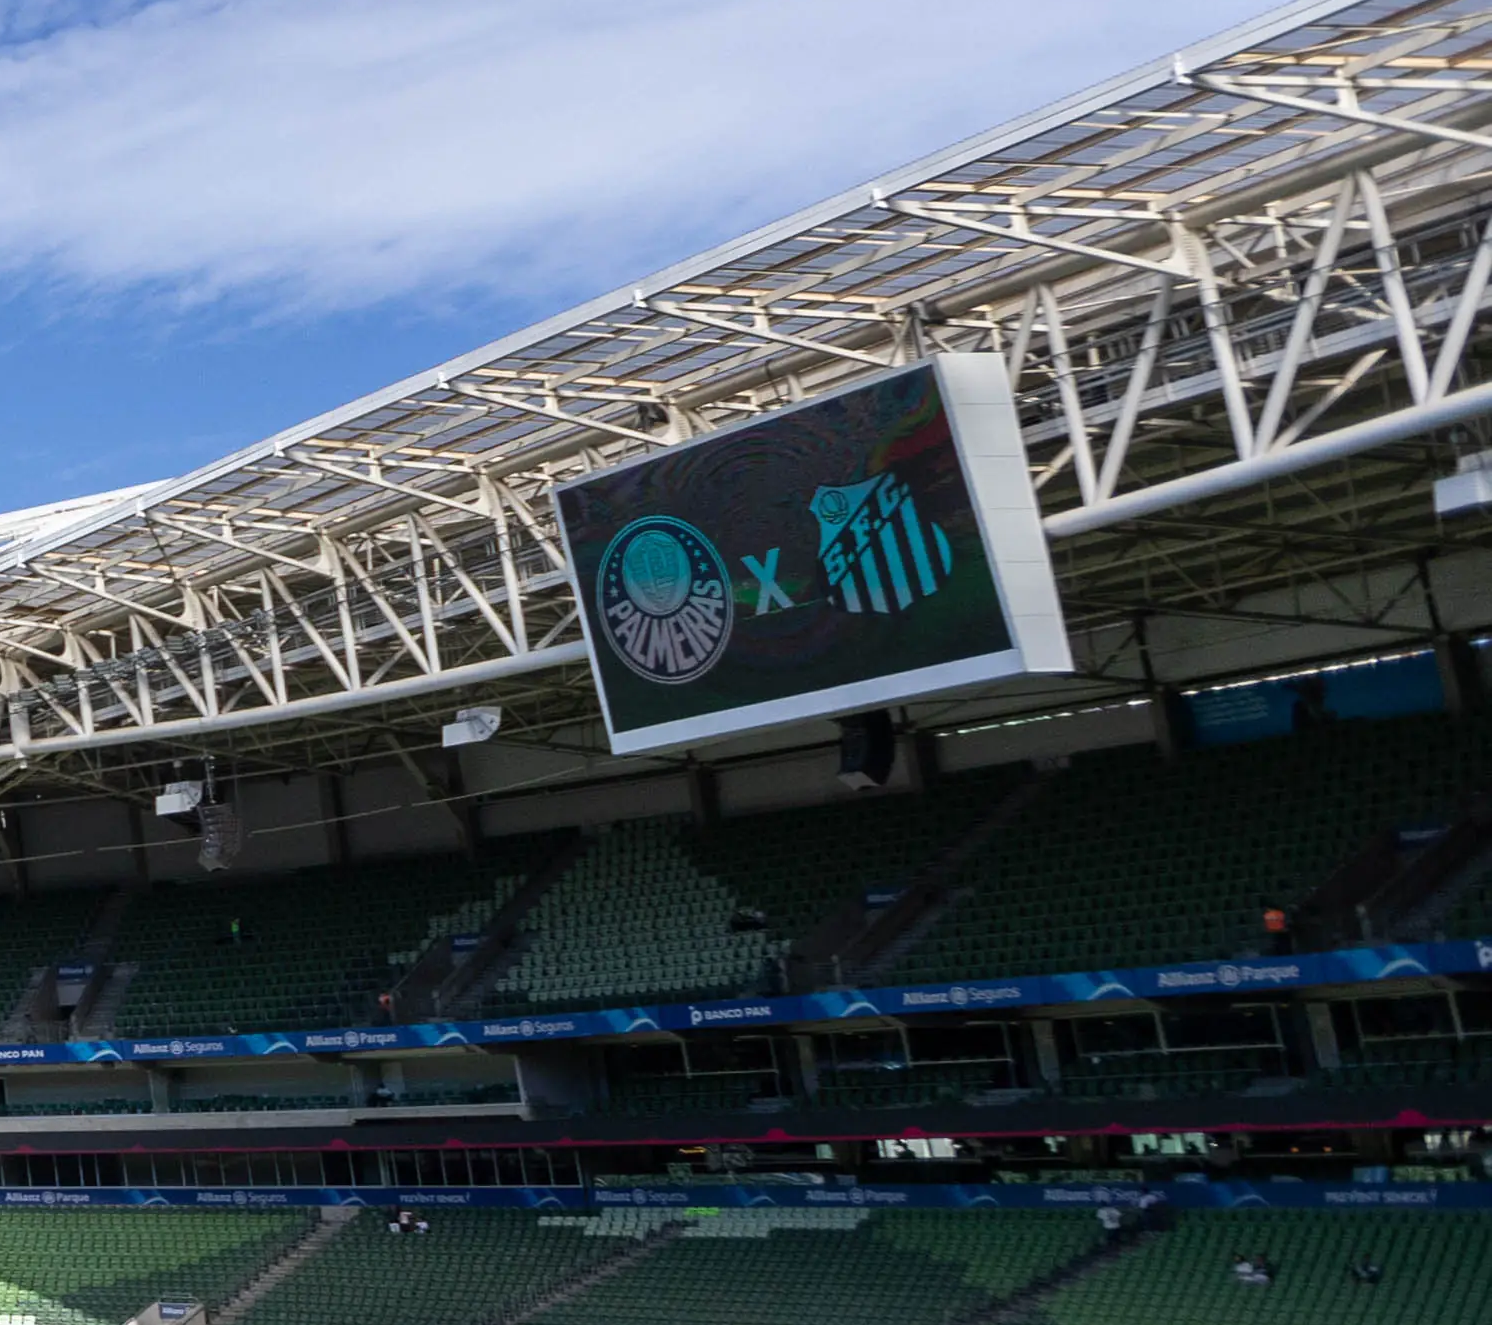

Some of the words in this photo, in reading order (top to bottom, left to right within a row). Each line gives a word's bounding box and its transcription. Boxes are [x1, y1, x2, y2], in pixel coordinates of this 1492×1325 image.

[606, 577, 725, 675] PALMEIRAS
[704, 1009, 743, 1023] BANCO
[746, 1006, 772, 1020] PAN
[22, 1049, 45, 1059] PAN
[133, 1042, 169, 1055] Allianz
[184, 1039, 224, 1055] Seguros
